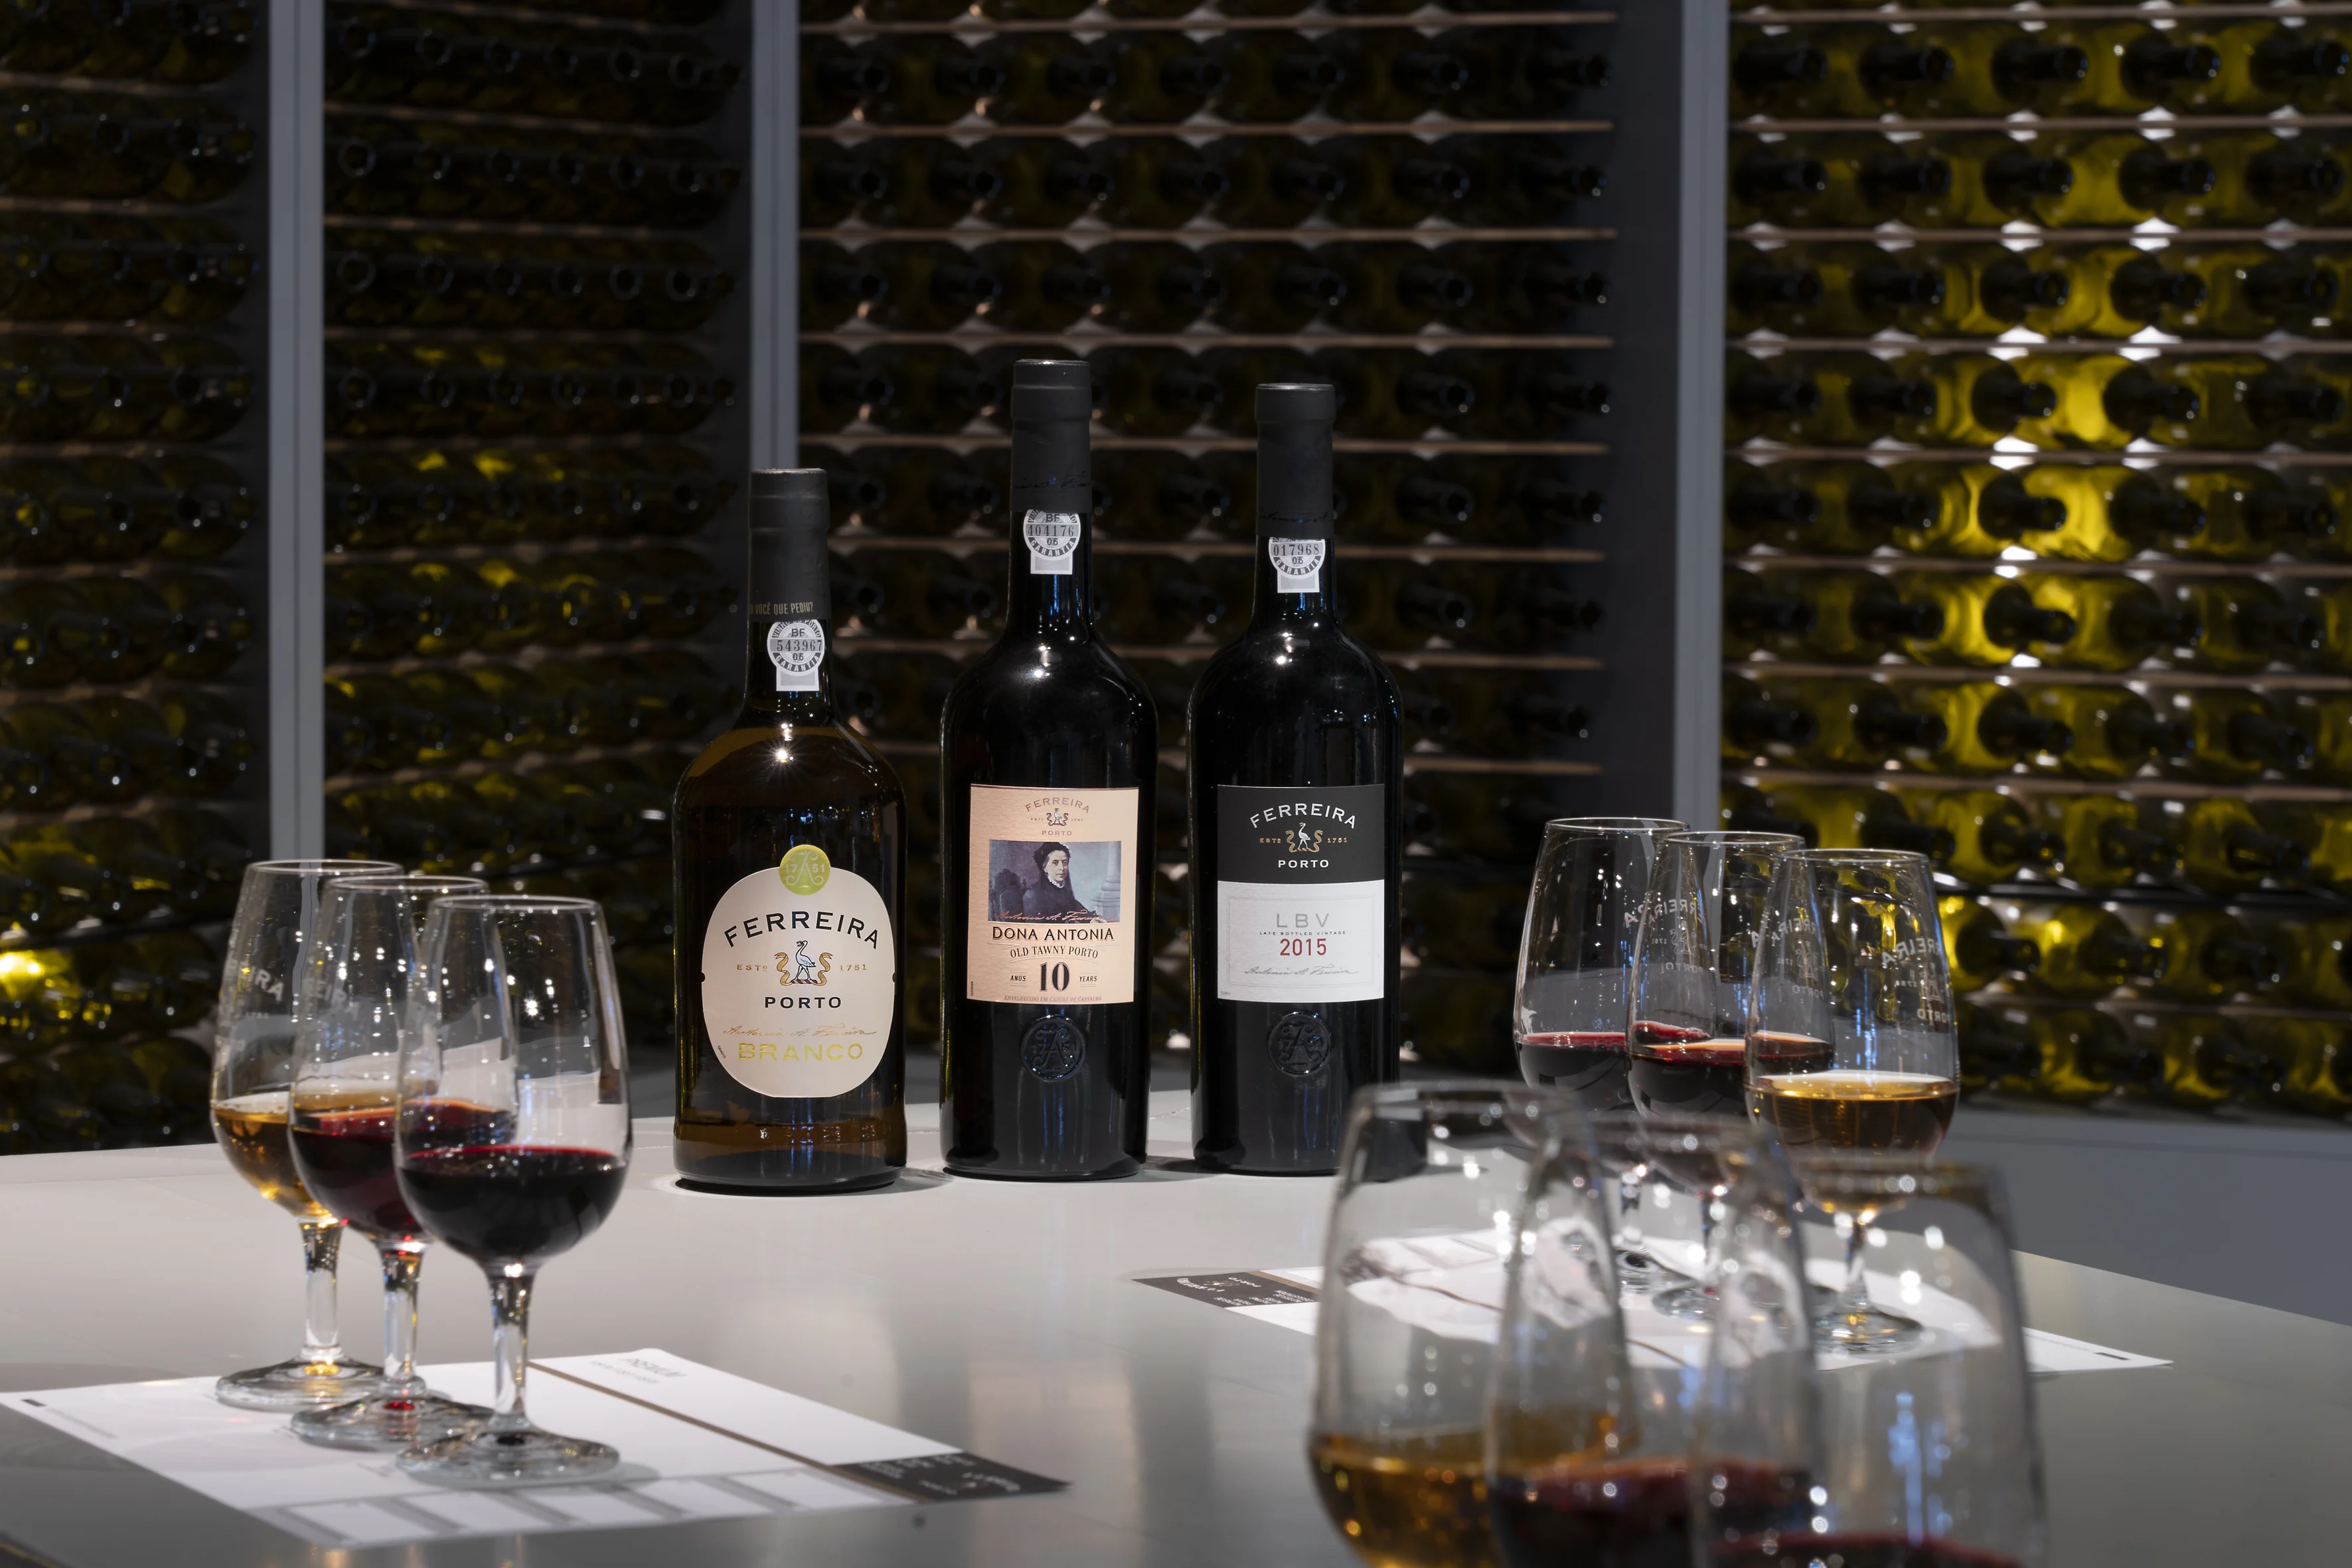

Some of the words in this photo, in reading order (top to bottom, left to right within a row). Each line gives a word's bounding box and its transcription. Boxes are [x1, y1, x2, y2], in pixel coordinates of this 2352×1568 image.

[1046, 514, 1060, 522] BF
[1028, 525, 1074, 537] 404176
[1031, 540, 1074, 556] GARANTIA
[1273, 544, 1319, 556] 017968
[1276, 559, 1319, 576] GARANTIA
[755, 601, 771, 615] VOCÊ
[773, 603, 789, 615] QUE
[791, 601, 813, 614] PEDIU?
[791, 629, 805, 637] BF
[777, 640, 822, 651] 543967
[776, 655, 819, 672] GARANTIA
[1025, 797, 1089, 813] FERREIRA
[1250, 803, 1356, 829] FERREIRA
[1278, 859, 1329, 868] PORTO
[1277, 913, 1329, 928] LBV
[724, 911, 878, 949] FERREIRA
[992, 926, 1038, 940] DONA
[1044, 927, 1114, 941] ANTONIA
[1010, 948, 1029, 959] OLD
[1032, 945, 1066, 955] TAWNY
[1068, 946, 1099, 959] PORTO
[1280, 938, 1326, 956] 2015
[838, 963, 867, 972] 1751
[1040, 962, 1069, 992] 10
[764, 996, 842, 1009] PORTO
[738, 1042, 863, 1061] BRANCO
